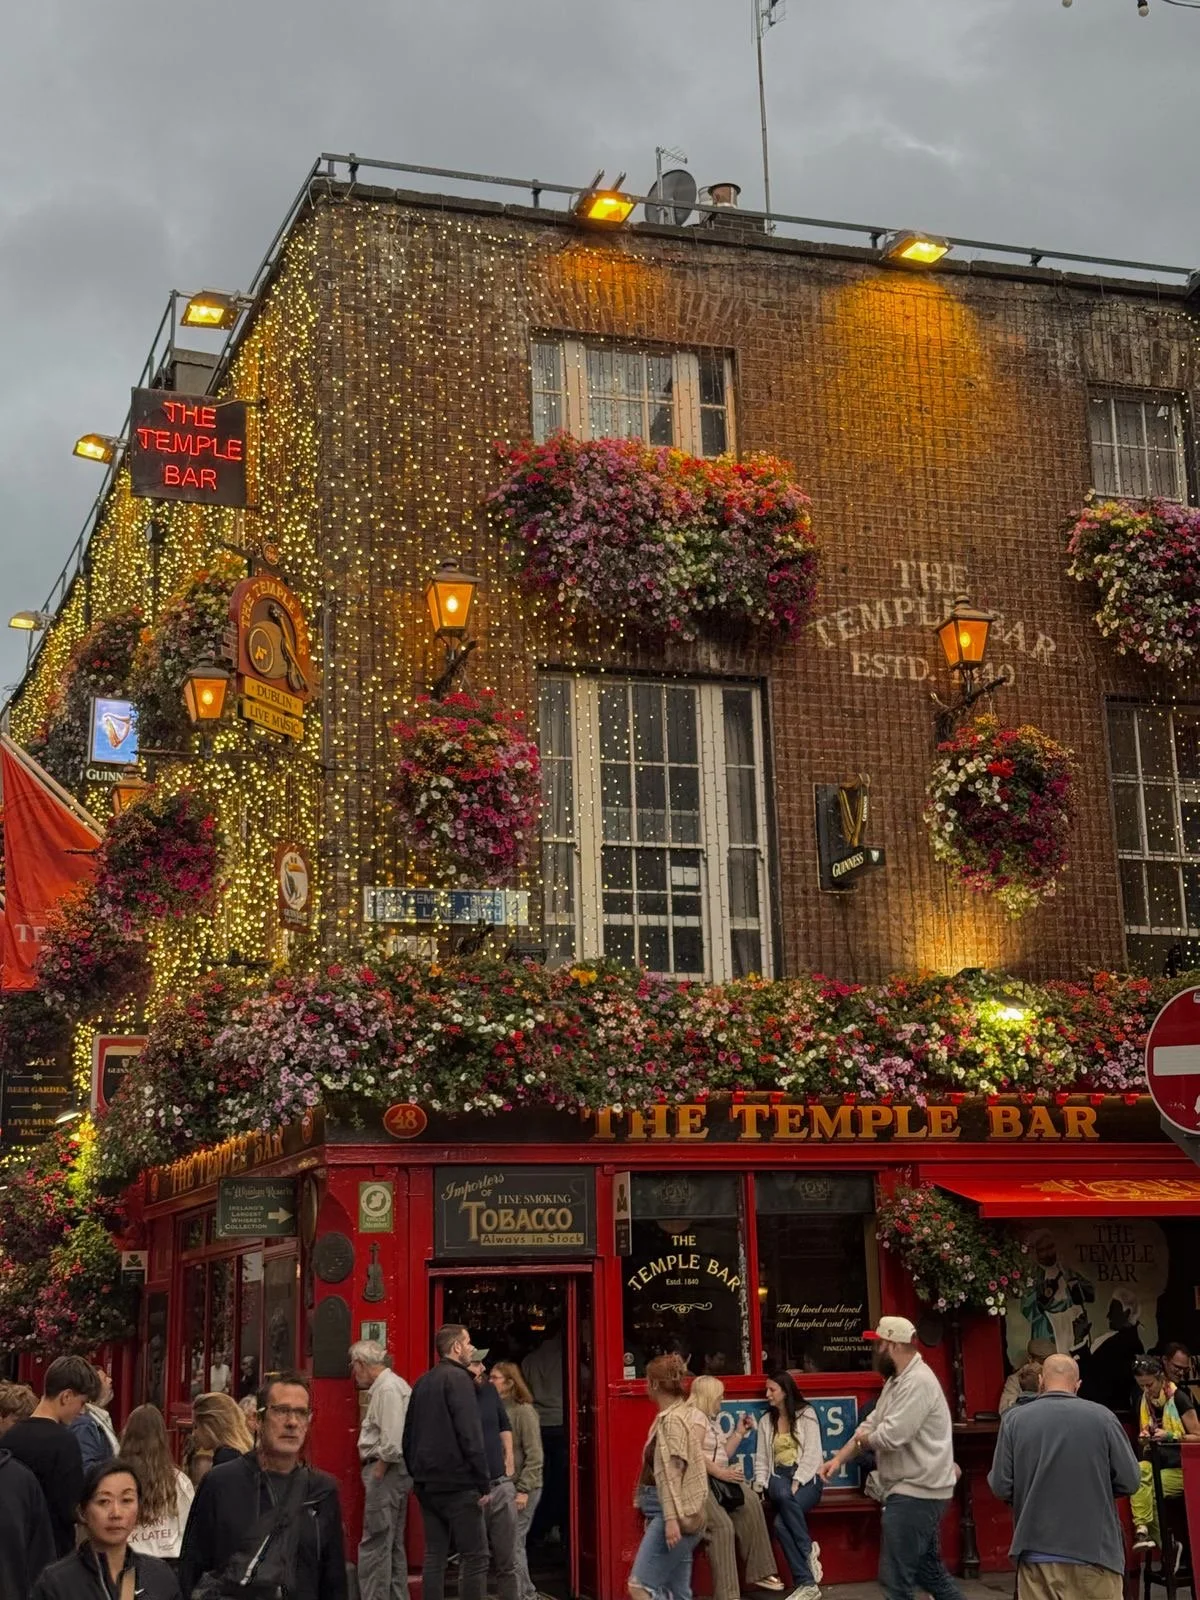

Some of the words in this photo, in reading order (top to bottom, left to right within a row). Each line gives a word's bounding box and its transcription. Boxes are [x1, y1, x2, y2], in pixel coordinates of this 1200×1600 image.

[163, 401, 217, 429] THE
[137, 428, 243, 461] TEMPLE
[165, 465, 217, 491] BAR
[893, 559, 969, 593] THE
[240, 593, 255, 629] THE
[252, 582, 296, 614] TEMPLE
[851, 650, 937, 681] ESTD.
[256, 684, 293, 710] DUBLIN
[249, 703, 270, 724] LIVE
[271, 713, 300, 736] MUSIC
[86, 769, 133, 783] GUINN
[832, 851, 865, 878] GUINNESS
[422, 907, 456, 919] LANE
[461, 908, 503, 919] SOUTH
[31, 1086, 68, 1094] GARDEN
[7, 1118, 31, 1126] LIVE
[32, 1118, 56, 1127] MUS
[391, 1110, 418, 1129] 48
[582, 1103, 709, 1139] THE
[730, 1103, 961, 1139] TEMPLE
[988, 1105, 1100, 1138] BAR
[170, 1158, 195, 1195] THE
[441, 1173, 505, 1201] Importers
[480, 1188, 493, 1197] OF
[498, 1194, 523, 1205] FINE
[524, 1194, 571, 1204] SMOKING
[458, 1201, 574, 1241] TOBACCO
[483, 1233, 526, 1244] Always
[532, 1233, 544, 1243] in
[547, 1233, 583, 1243] Stock
[671, 1235, 697, 1247] THE
[1093, 1224, 1136, 1243] THE
[1075, 1243, 1155, 1264] TEMPLE
[627, 1254, 700, 1292] TEMPLE
[706, 1258, 741, 1293] BAR
[684, 1278, 700, 1286] 1840
[1096, 1263, 1138, 1283] BAR
[801, 1303, 822, 1314] lived
[822, 1303, 839, 1314] and
[839, 1303, 863, 1314] loved
[776, 1318, 795, 1328] and
[794, 1318, 828, 1331] laughed
[827, 1318, 843, 1328] and
